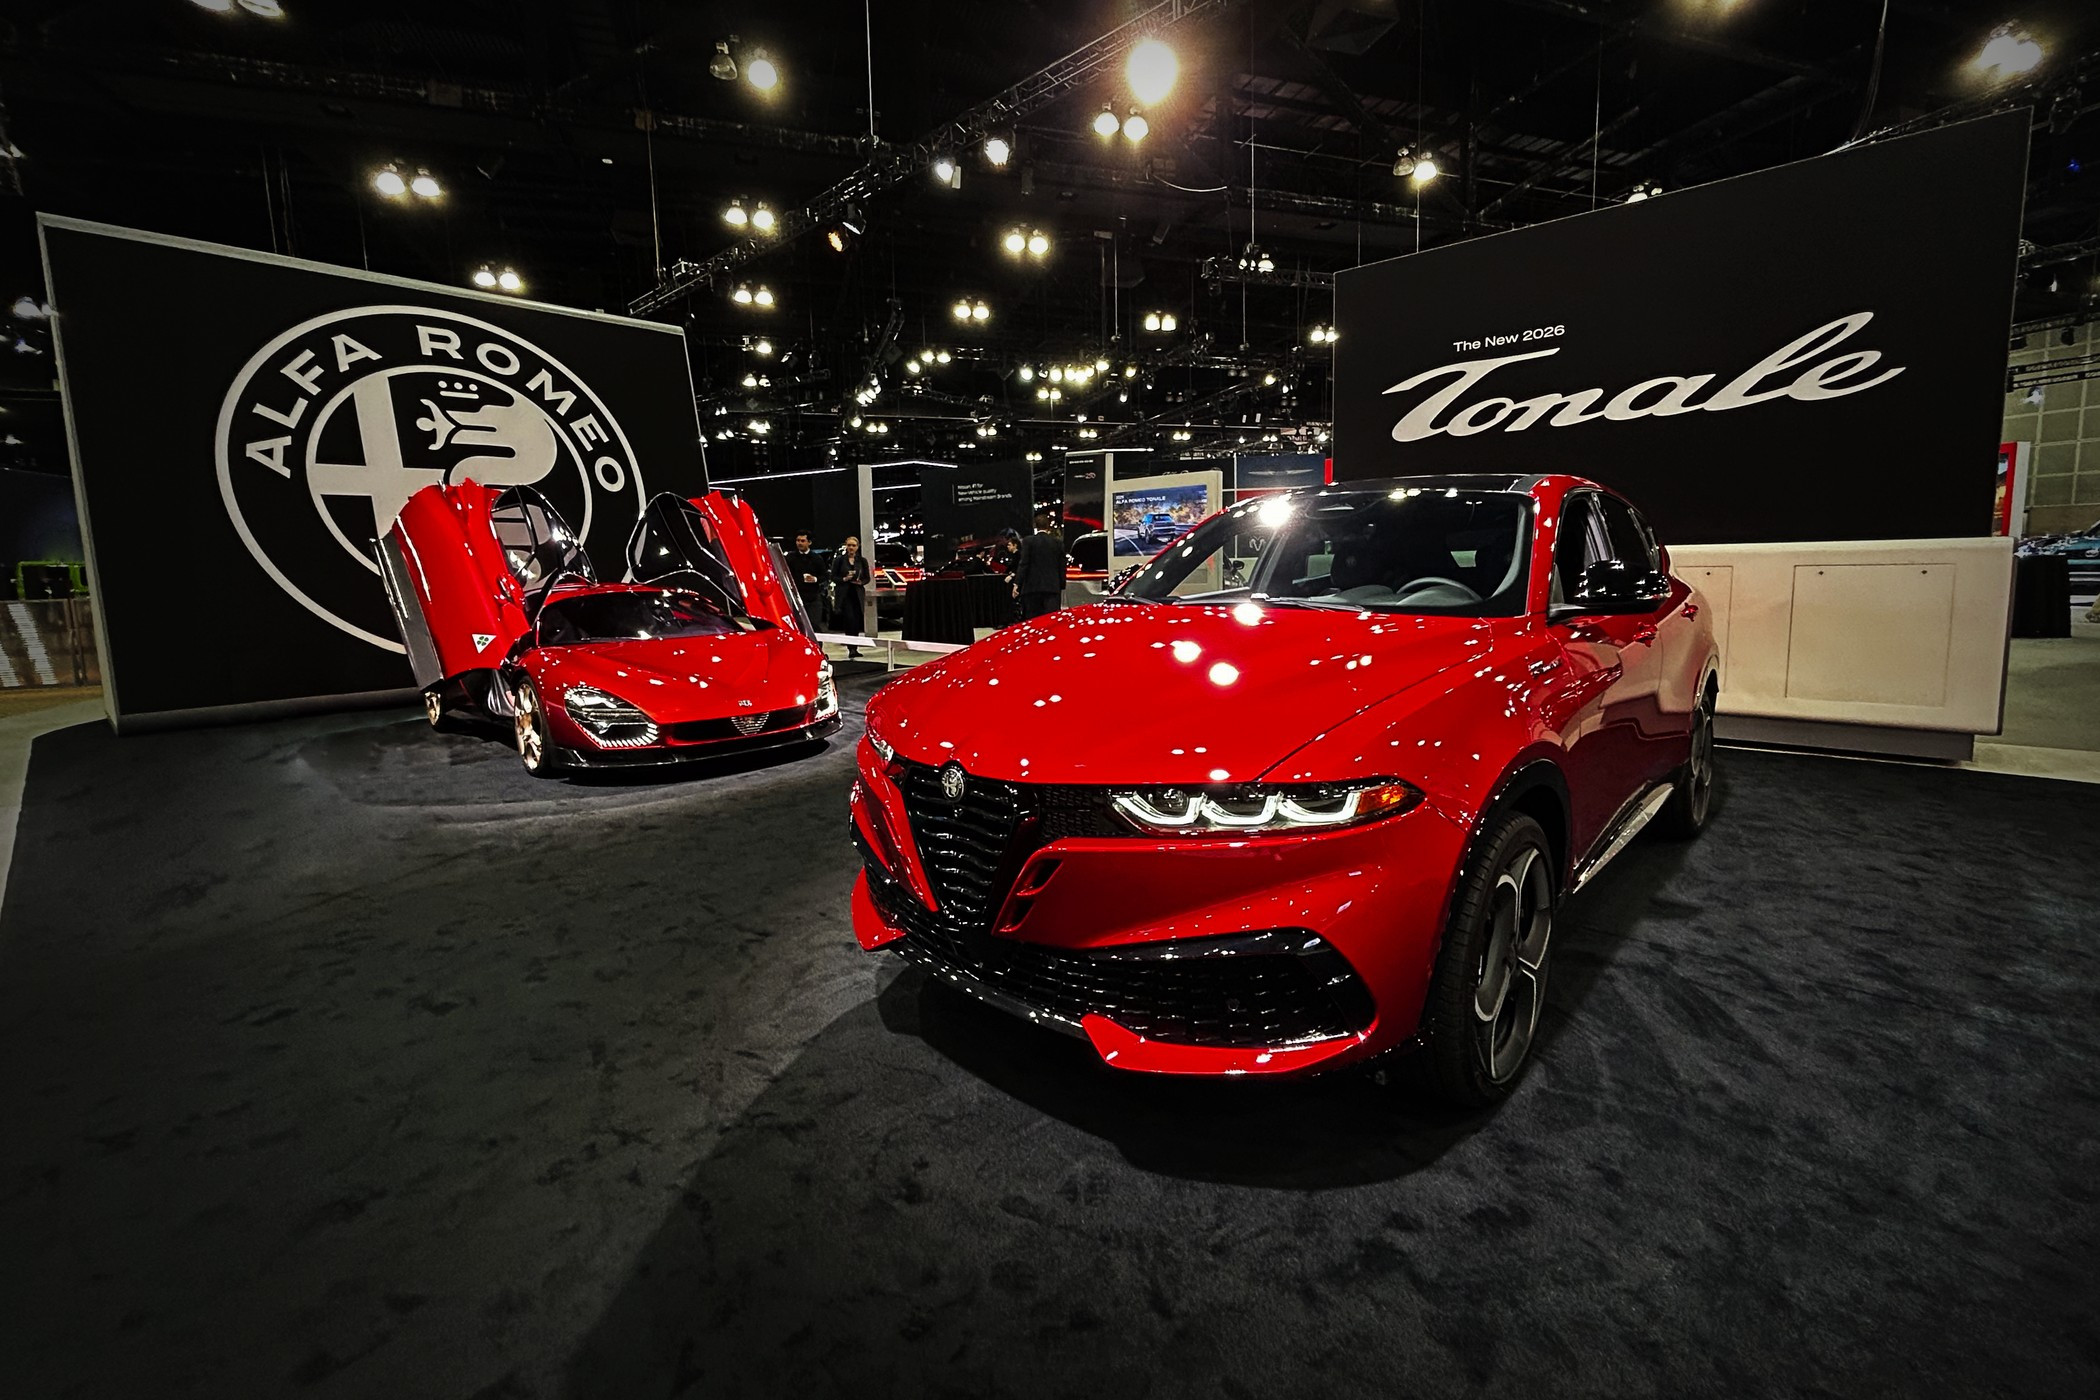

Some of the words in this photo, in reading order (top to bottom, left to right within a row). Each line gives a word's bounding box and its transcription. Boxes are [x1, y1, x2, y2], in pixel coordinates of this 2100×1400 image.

[1382, 311, 1906, 442] Tonale
[1453, 340, 1482, 352] The
[1484, 333, 1519, 348] New
[1522, 324, 1566, 342] 2026
[245, 333, 383, 478] ALFA
[415, 324, 625, 492] ROMEO
